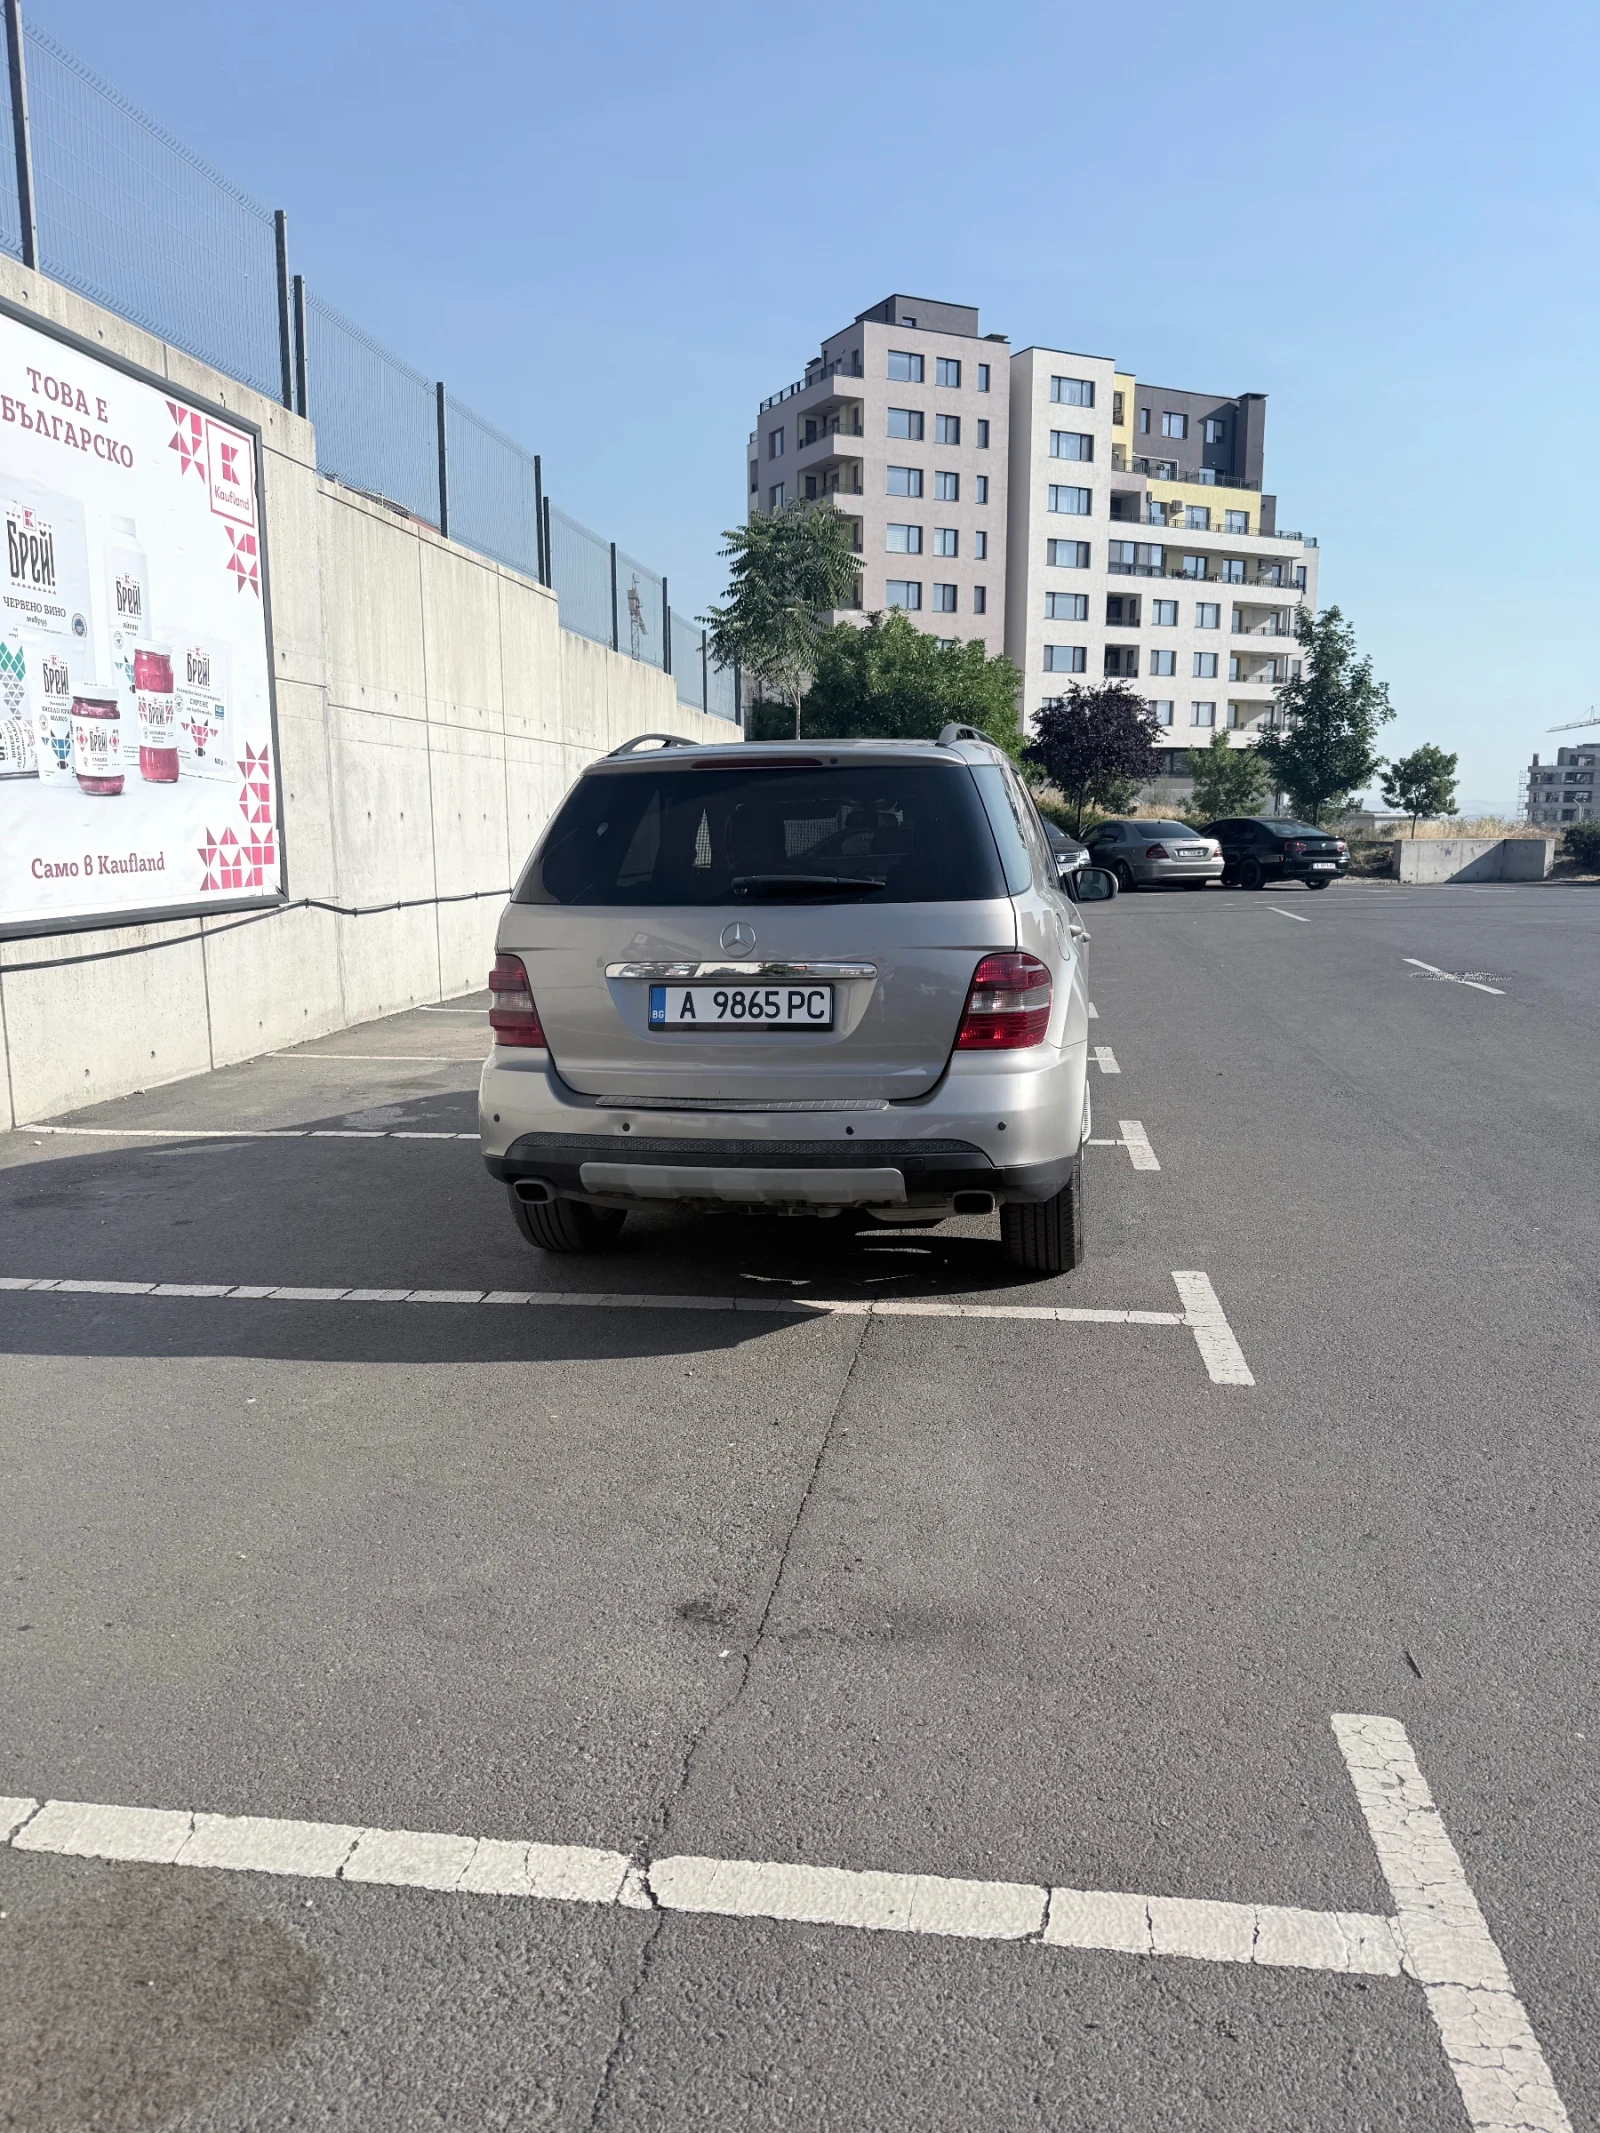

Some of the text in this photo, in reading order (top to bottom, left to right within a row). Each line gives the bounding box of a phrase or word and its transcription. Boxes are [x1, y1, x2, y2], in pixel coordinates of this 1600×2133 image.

[26, 366, 109, 423] ТОВА Е
[0, 394, 134, 468] БЪЛГАРСКО
[214, 485, 250, 511] Kaufland
[2, 596, 67, 618] ЧЕРВЕНО ВИНО
[31, 858, 79, 879] Само
[98, 851, 165, 875] Kaufland
[652, 1010, 664, 1019] BG
[679, 991, 825, 1019] A 9865 PC
